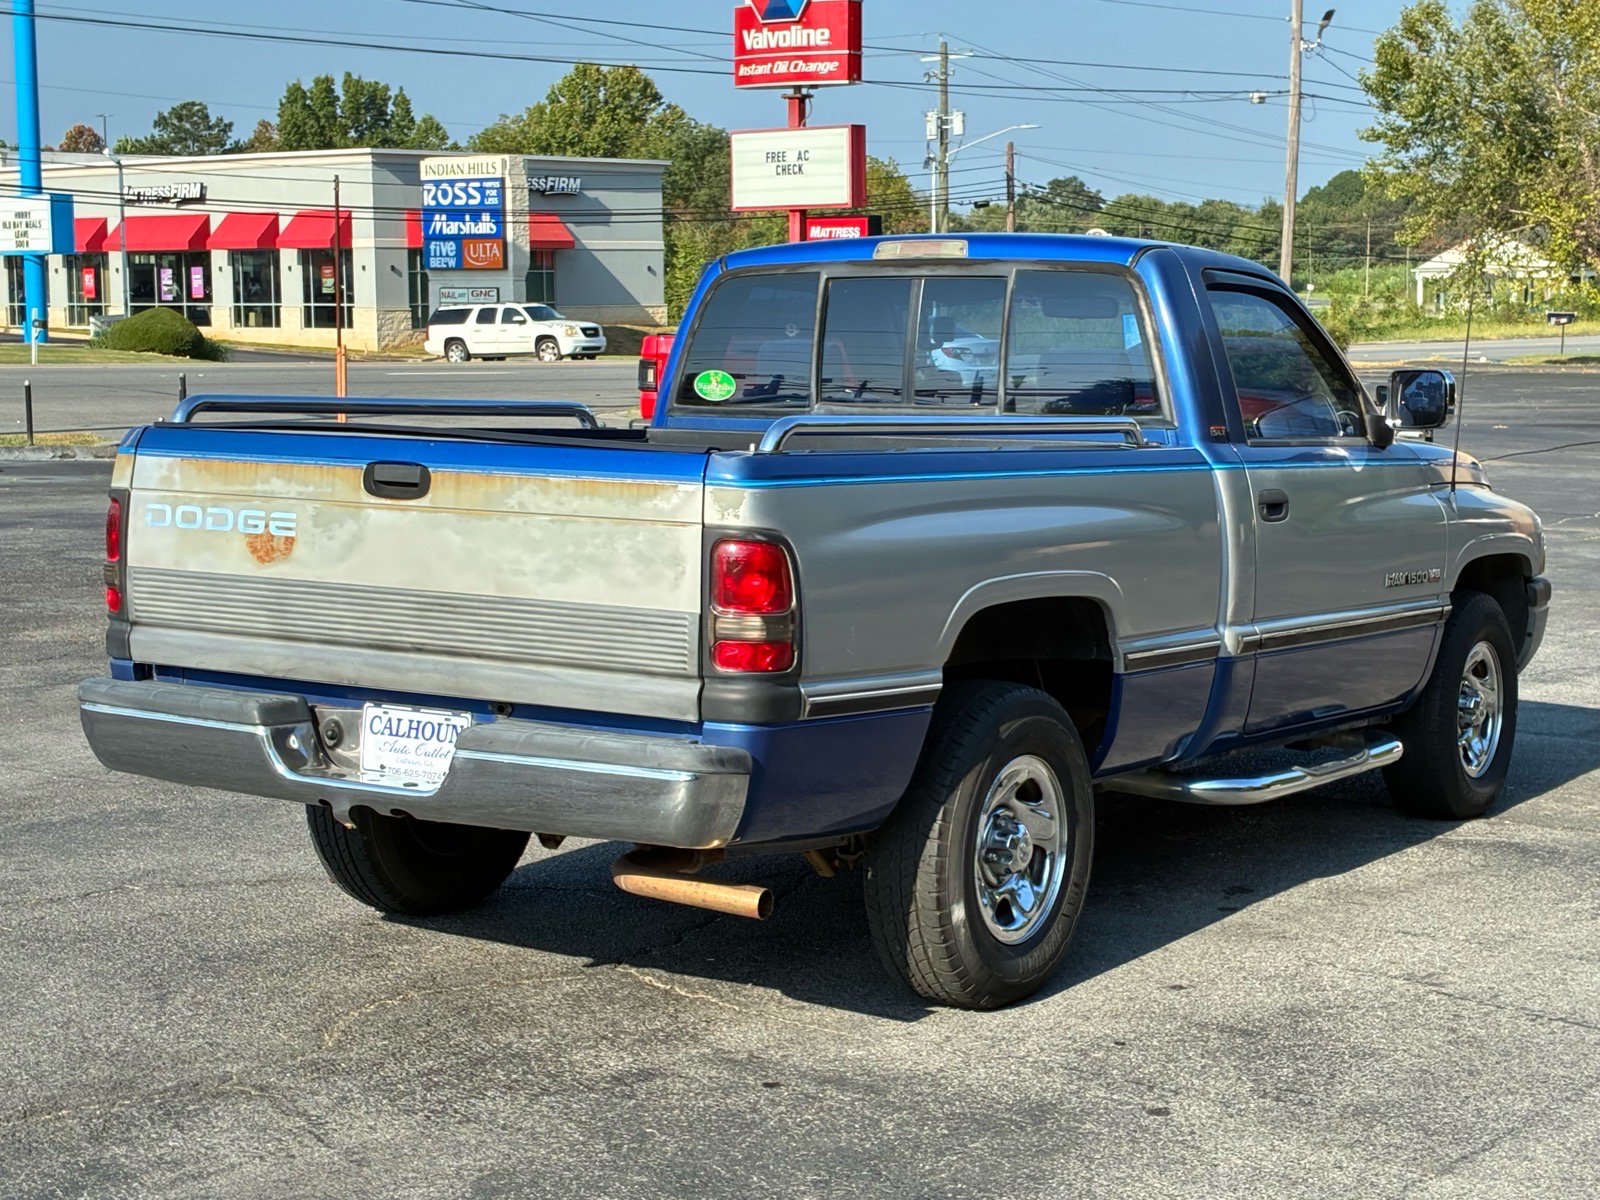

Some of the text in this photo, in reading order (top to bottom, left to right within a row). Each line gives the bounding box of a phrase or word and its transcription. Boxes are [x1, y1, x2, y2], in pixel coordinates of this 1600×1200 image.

[742, 25, 830, 51] Valvoline
[738, 60, 840, 77] Instant Oil Change
[765, 150, 810, 163] FREE AC
[425, 161, 497, 177] INDIAN HILLS
[776, 163, 804, 176] CHECK
[423, 182, 481, 207] ROSS
[485, 189, 498, 197] FOR
[484, 197, 499, 205] LESS
[429, 212, 497, 235] Marshalls
[14, 230, 29, 239] LEAVE
[810, 226, 861, 239] MATTRESS
[429, 241, 457, 257] five
[469, 243, 500, 258] ULTA
[429, 257, 457, 268] BELOW
[471, 289, 495, 298] GNC
[143, 503, 297, 537] DODGE
[1408, 570, 1429, 584] 1500
[369, 715, 465, 744] CALHOUN
[379, 739, 451, 759] Auto Outlet
[387, 767, 442, 780] 706-625-7074
